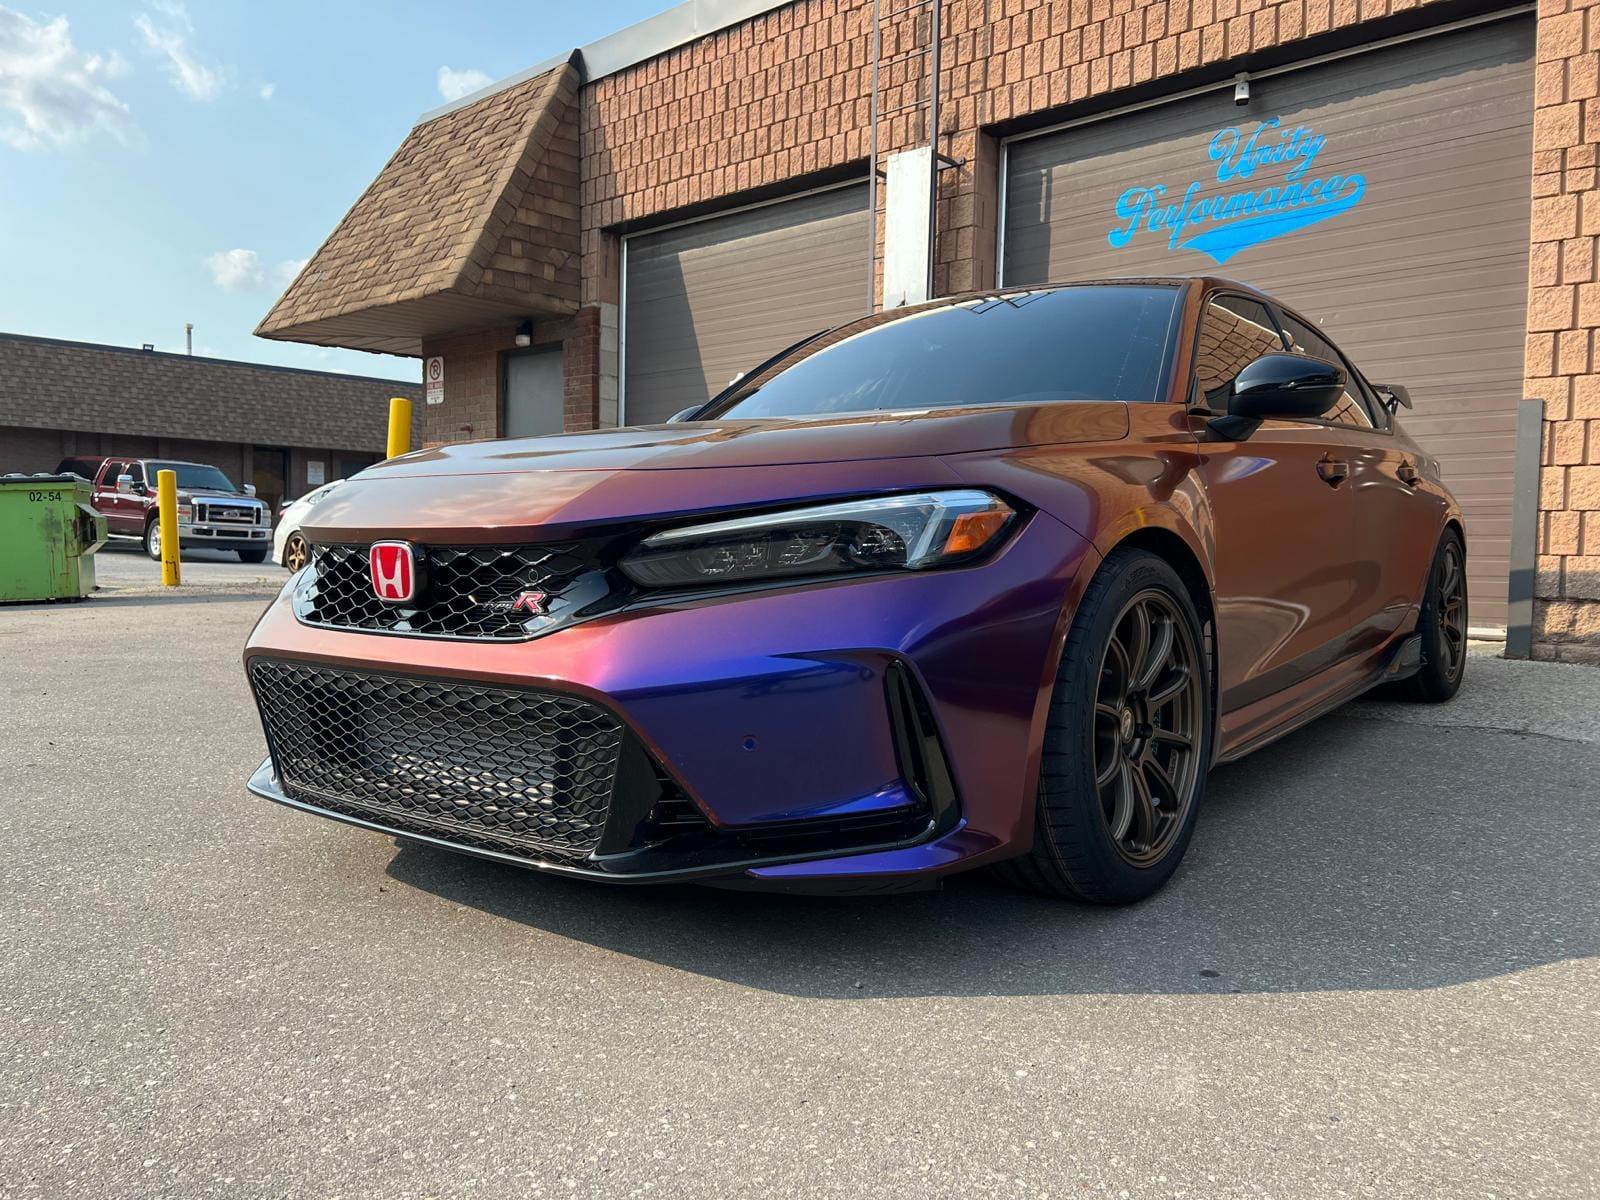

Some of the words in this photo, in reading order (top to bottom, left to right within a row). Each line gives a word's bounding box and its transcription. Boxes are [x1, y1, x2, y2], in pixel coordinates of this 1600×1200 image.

[1208, 116, 1327, 182] Unity
[1107, 173, 1344, 249] Performance
[29, 491, 61, 502] 02-54
[512, 590, 546, 613] R
